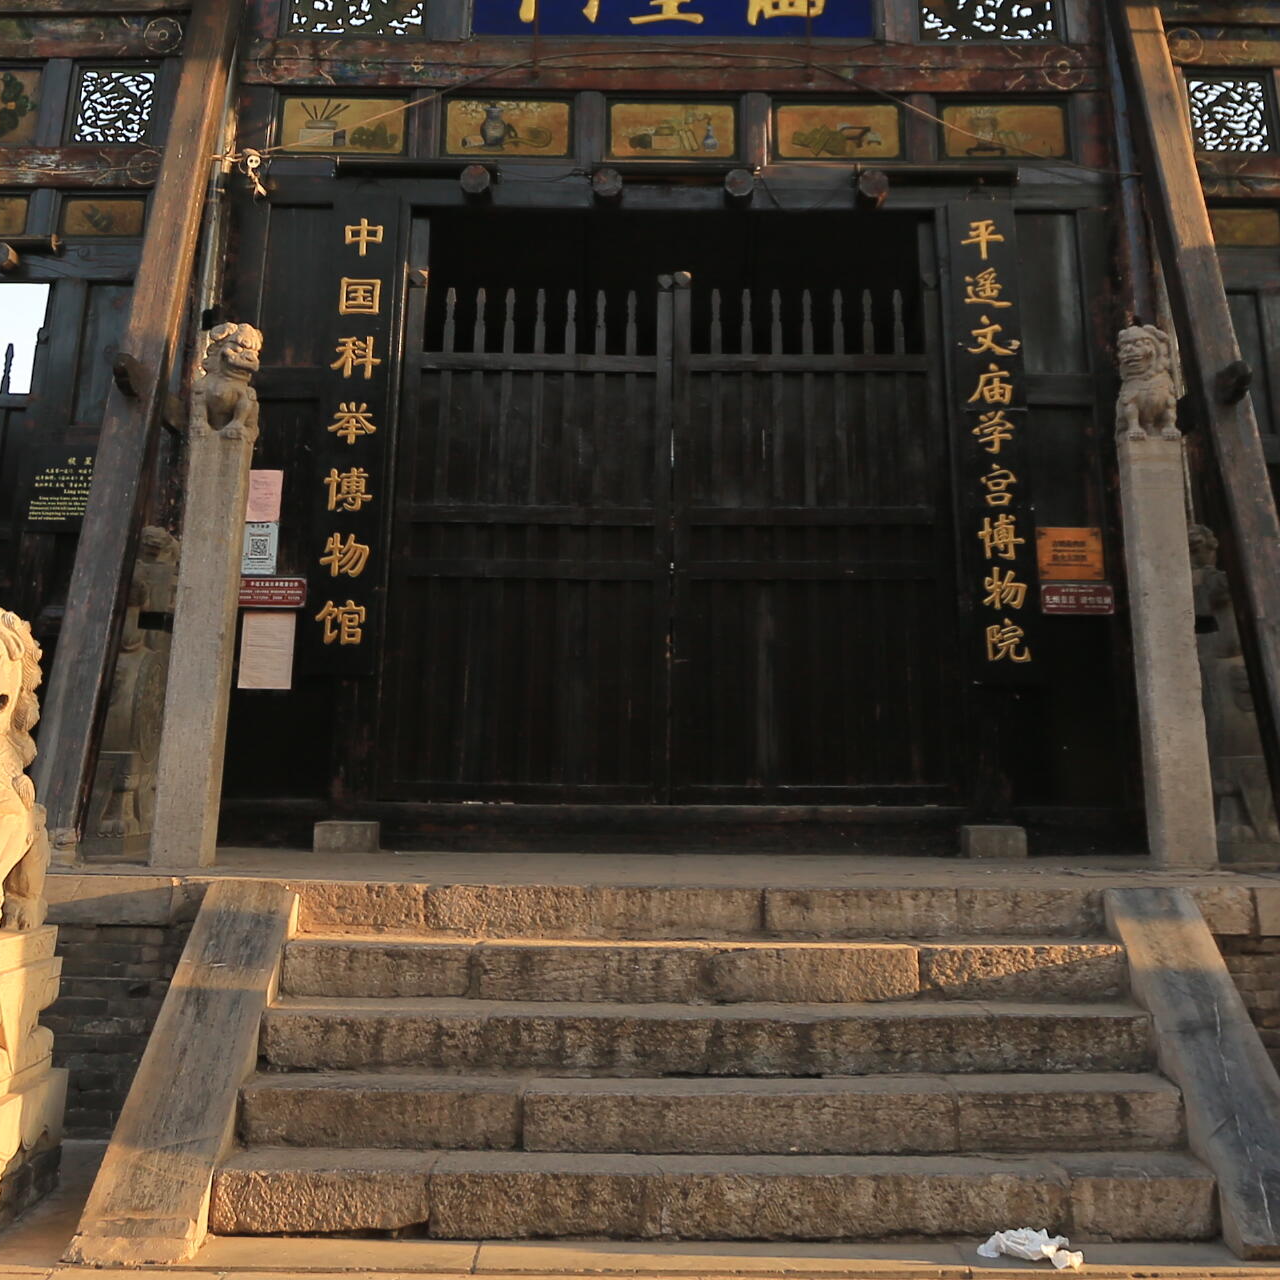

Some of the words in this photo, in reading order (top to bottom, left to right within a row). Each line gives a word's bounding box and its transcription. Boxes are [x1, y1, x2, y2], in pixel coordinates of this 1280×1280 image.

[315, 217, 384, 646] 中国科举博物馆
[961, 219, 1032, 663] 平遥文庙学宫博物院
